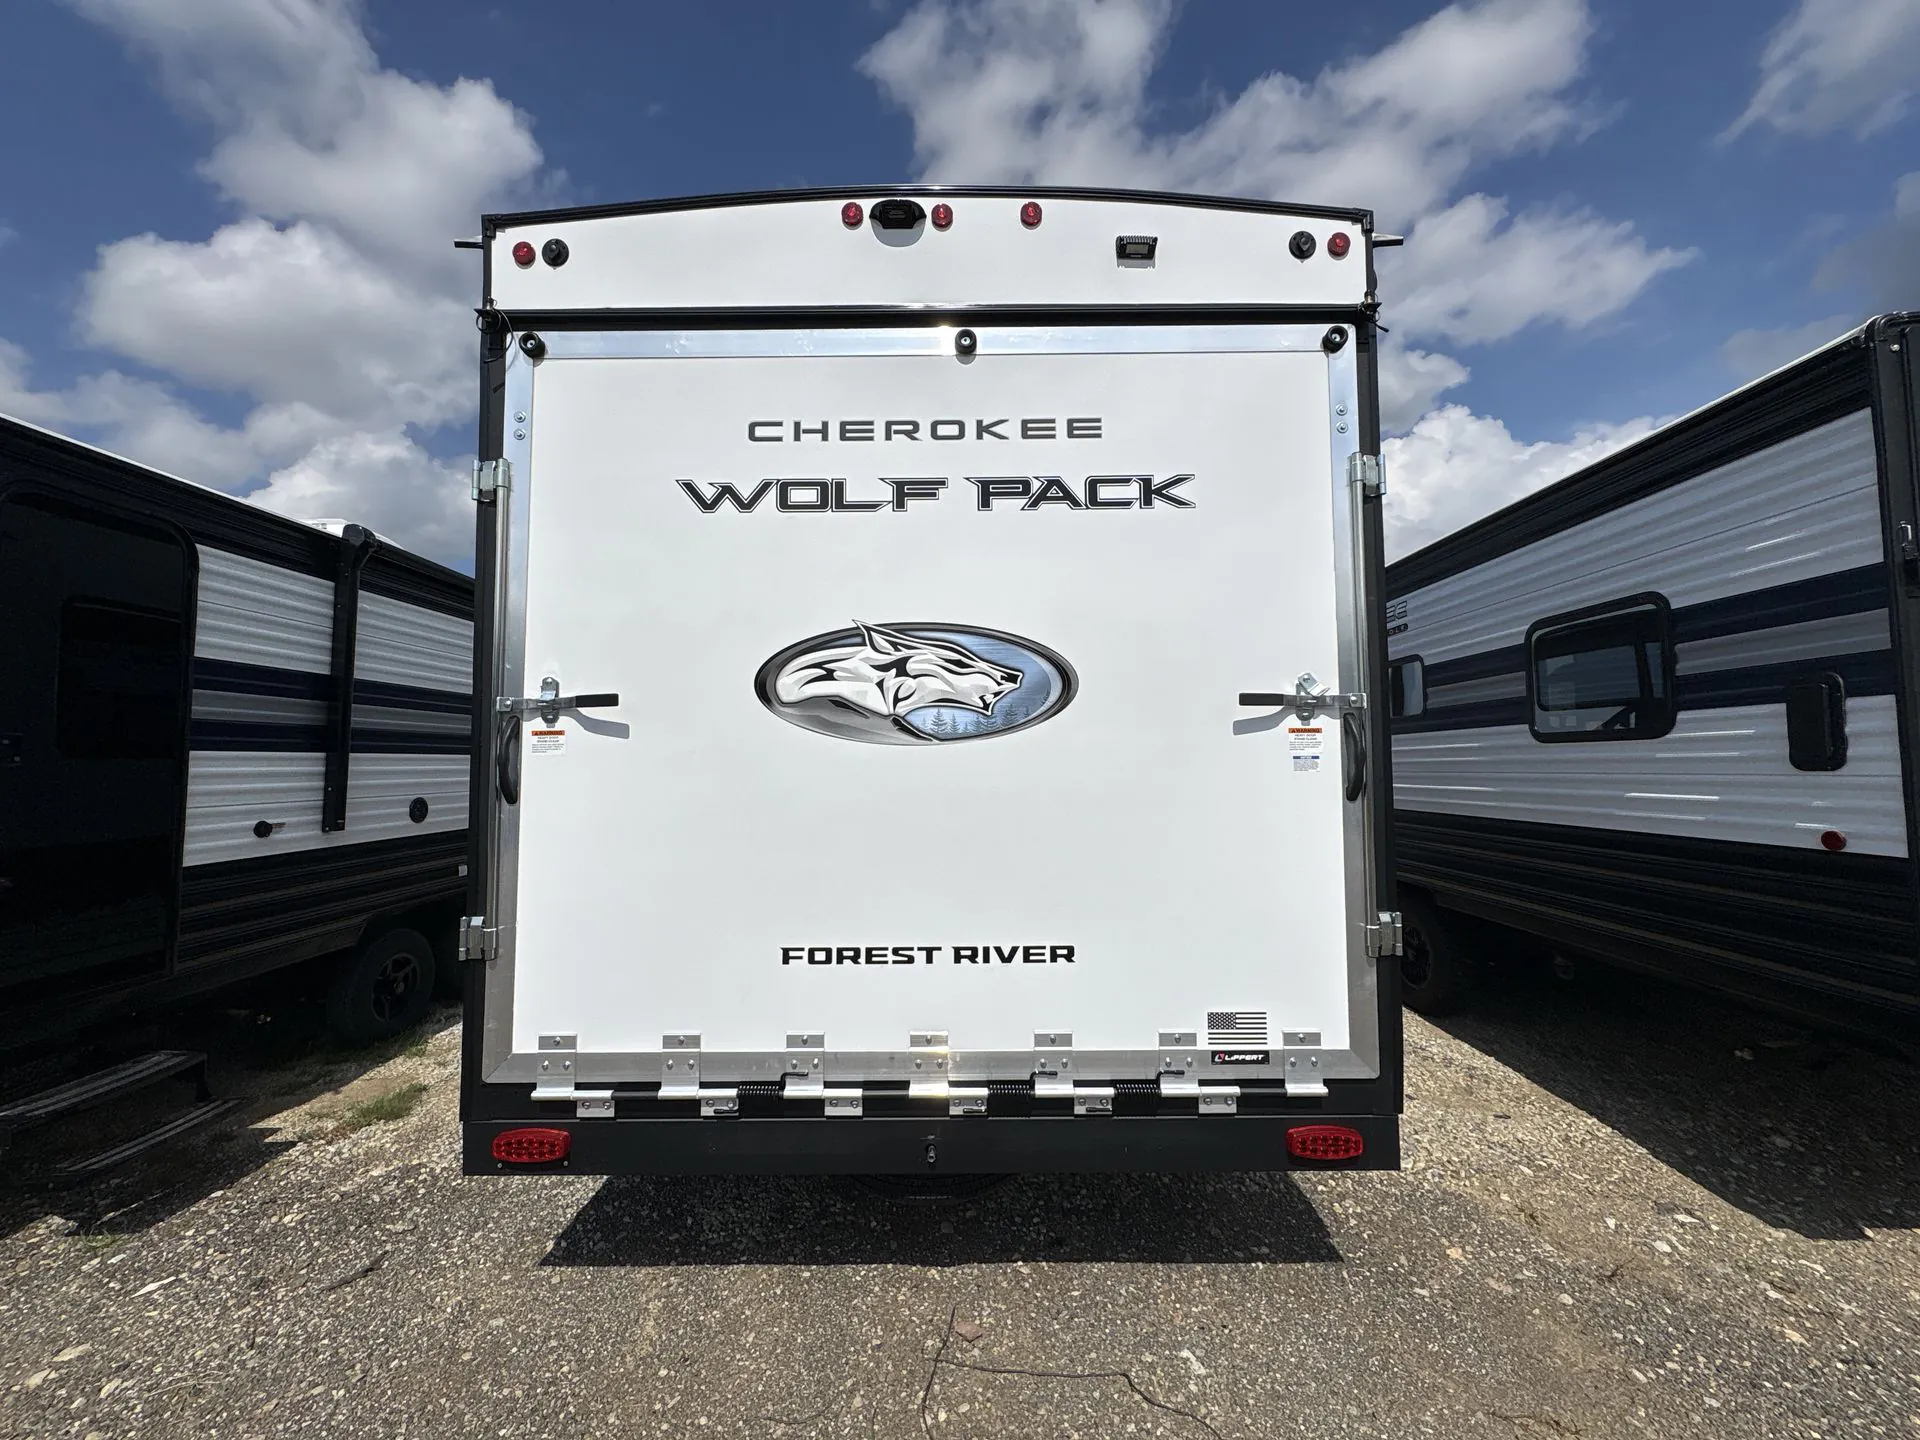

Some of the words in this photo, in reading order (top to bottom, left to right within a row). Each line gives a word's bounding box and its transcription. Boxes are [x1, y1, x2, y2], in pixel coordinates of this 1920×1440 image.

[747, 417, 1103, 442] CHEROKEE
[675, 477, 949, 514] WOLF
[963, 473, 1197, 512] PACK
[779, 945, 943, 965] FOREST
[951, 945, 1077, 964] RIVER
